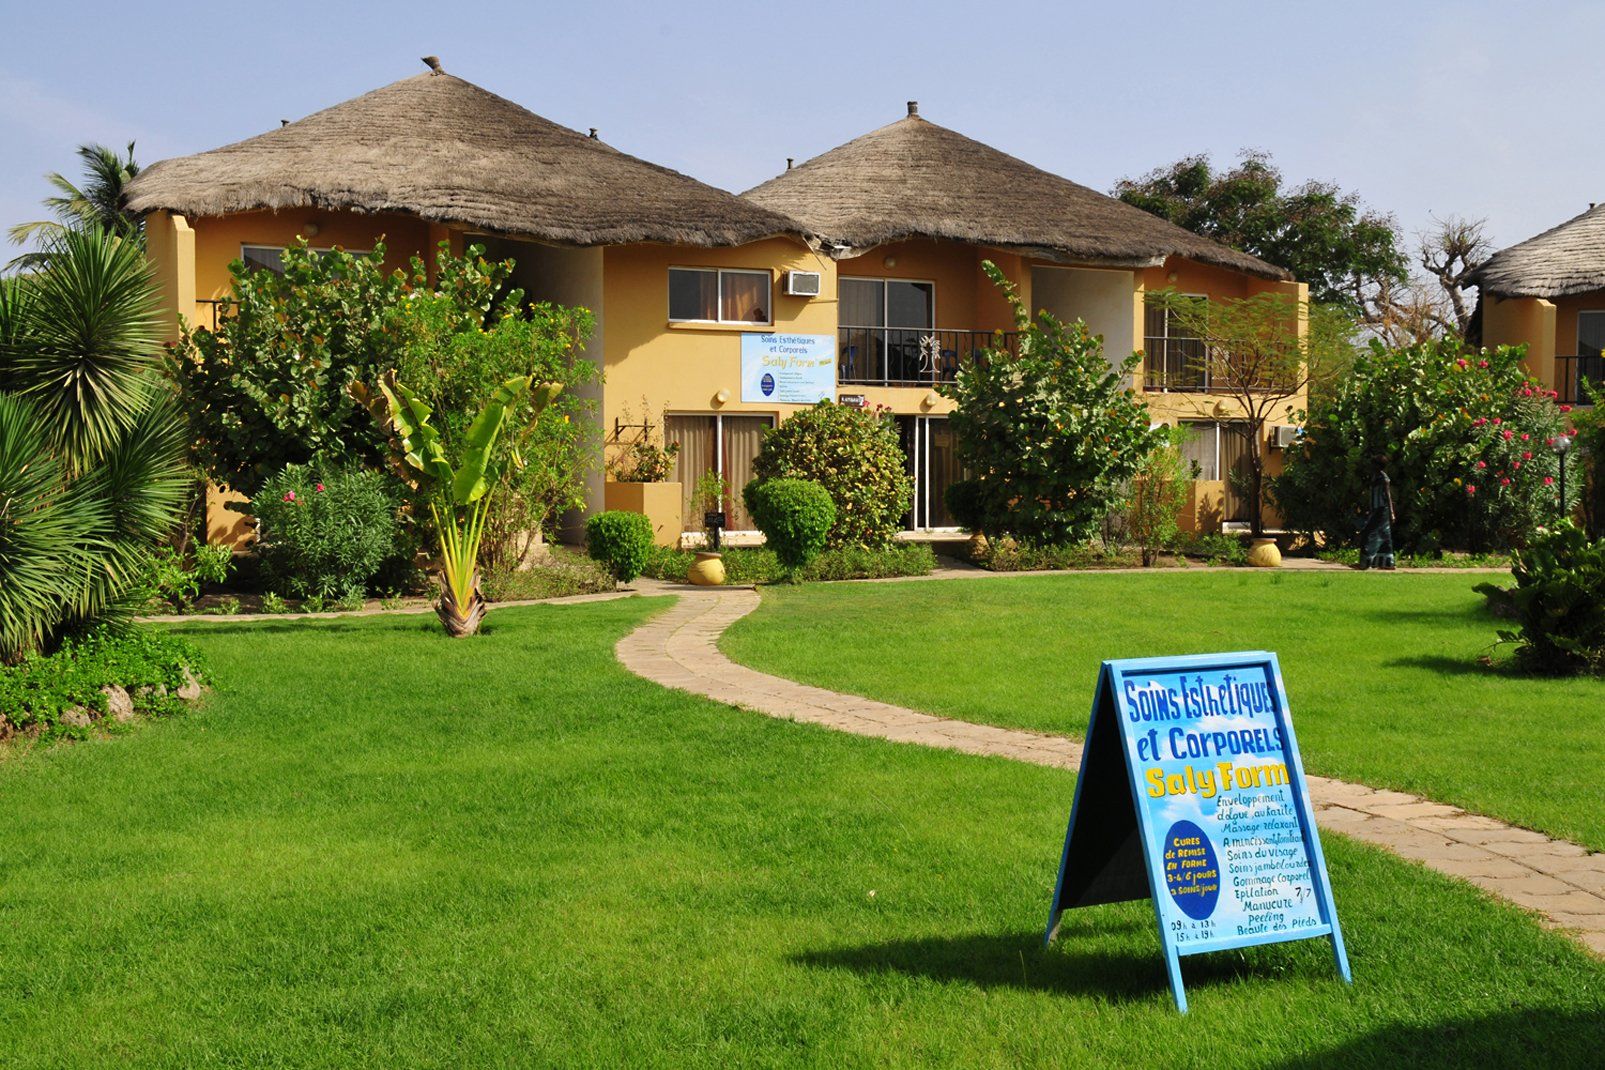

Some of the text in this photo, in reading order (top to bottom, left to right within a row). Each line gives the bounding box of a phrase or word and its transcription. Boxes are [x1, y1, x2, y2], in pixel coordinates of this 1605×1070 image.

[761, 335, 777, 343] Soins
[778, 346, 808, 354] Corporels
[762, 356, 787, 369] Saly
[789, 354, 815, 367] Form
[1137, 728, 1161, 761] et
[1145, 761, 1291, 798] Saly Form
[1216, 789, 1285, 807] Enveloppement
[1221, 823, 1260, 834] Massage
[1227, 850, 1253, 861] Soins
[1254, 848, 1267, 858] du
[1181, 859, 1207, 869] FORME
[1229, 863, 1253, 874] Soins
